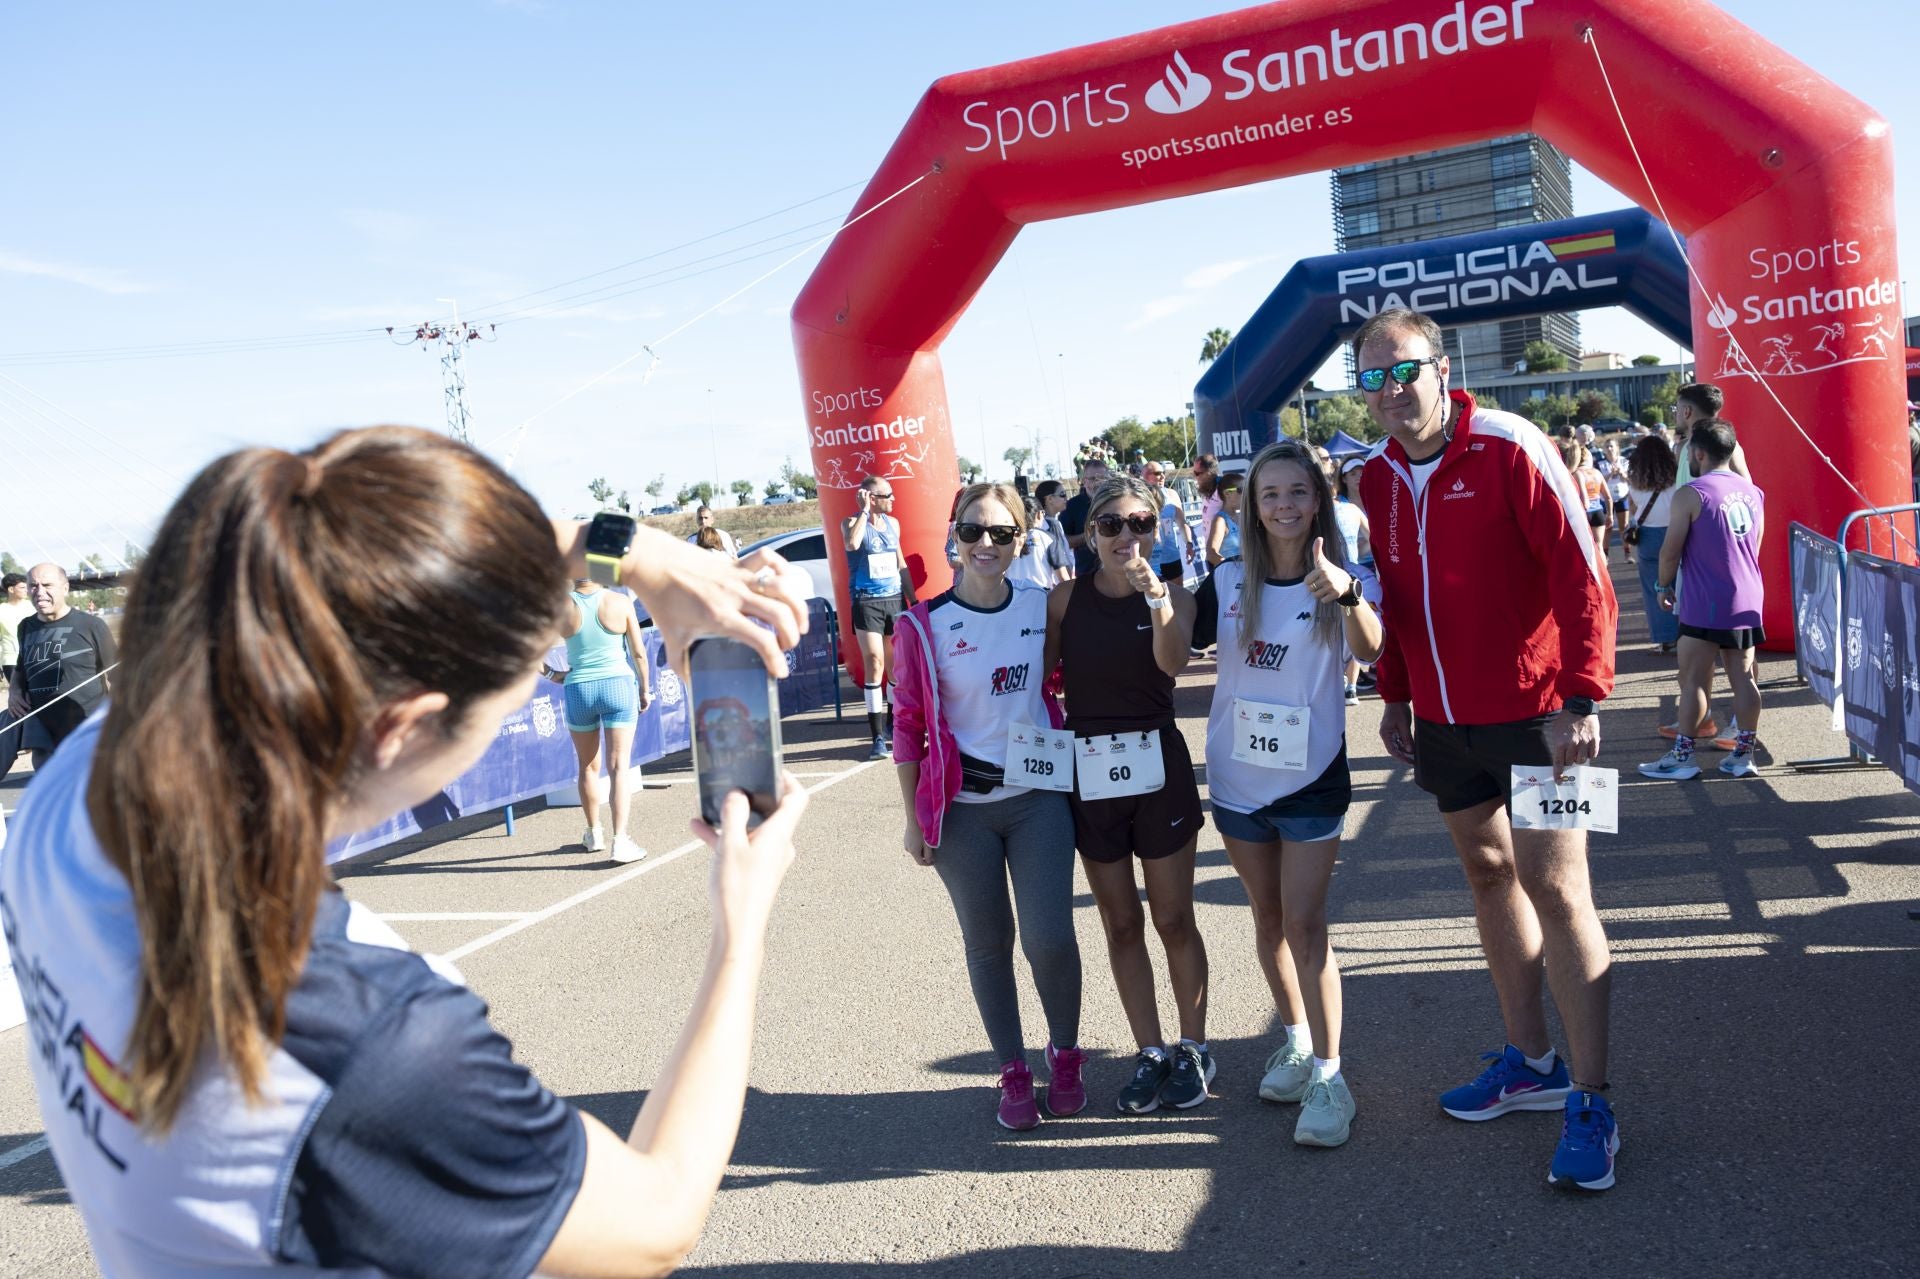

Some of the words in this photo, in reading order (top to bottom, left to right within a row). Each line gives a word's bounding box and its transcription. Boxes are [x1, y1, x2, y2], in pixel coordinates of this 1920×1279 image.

[963, 81, 1130, 161] Sports
[1222, 0, 1534, 101] Santander
[1121, 106, 1353, 169] sportssantander.es
[1750, 238, 1861, 284] Sports
[1340, 263, 1618, 323] NACIONAL
[1742, 277, 1897, 325] Santander
[812, 386, 883, 419] Sports
[814, 415, 926, 448] Santander
[1212, 430, 1252, 457] RUTA
[1443, 490, 1475, 501] Santander
[1249, 734, 1279, 753] 216
[1023, 757, 1054, 776] 1289
[1109, 765, 1131, 782] 60
[1538, 799, 1592, 815] 1204
